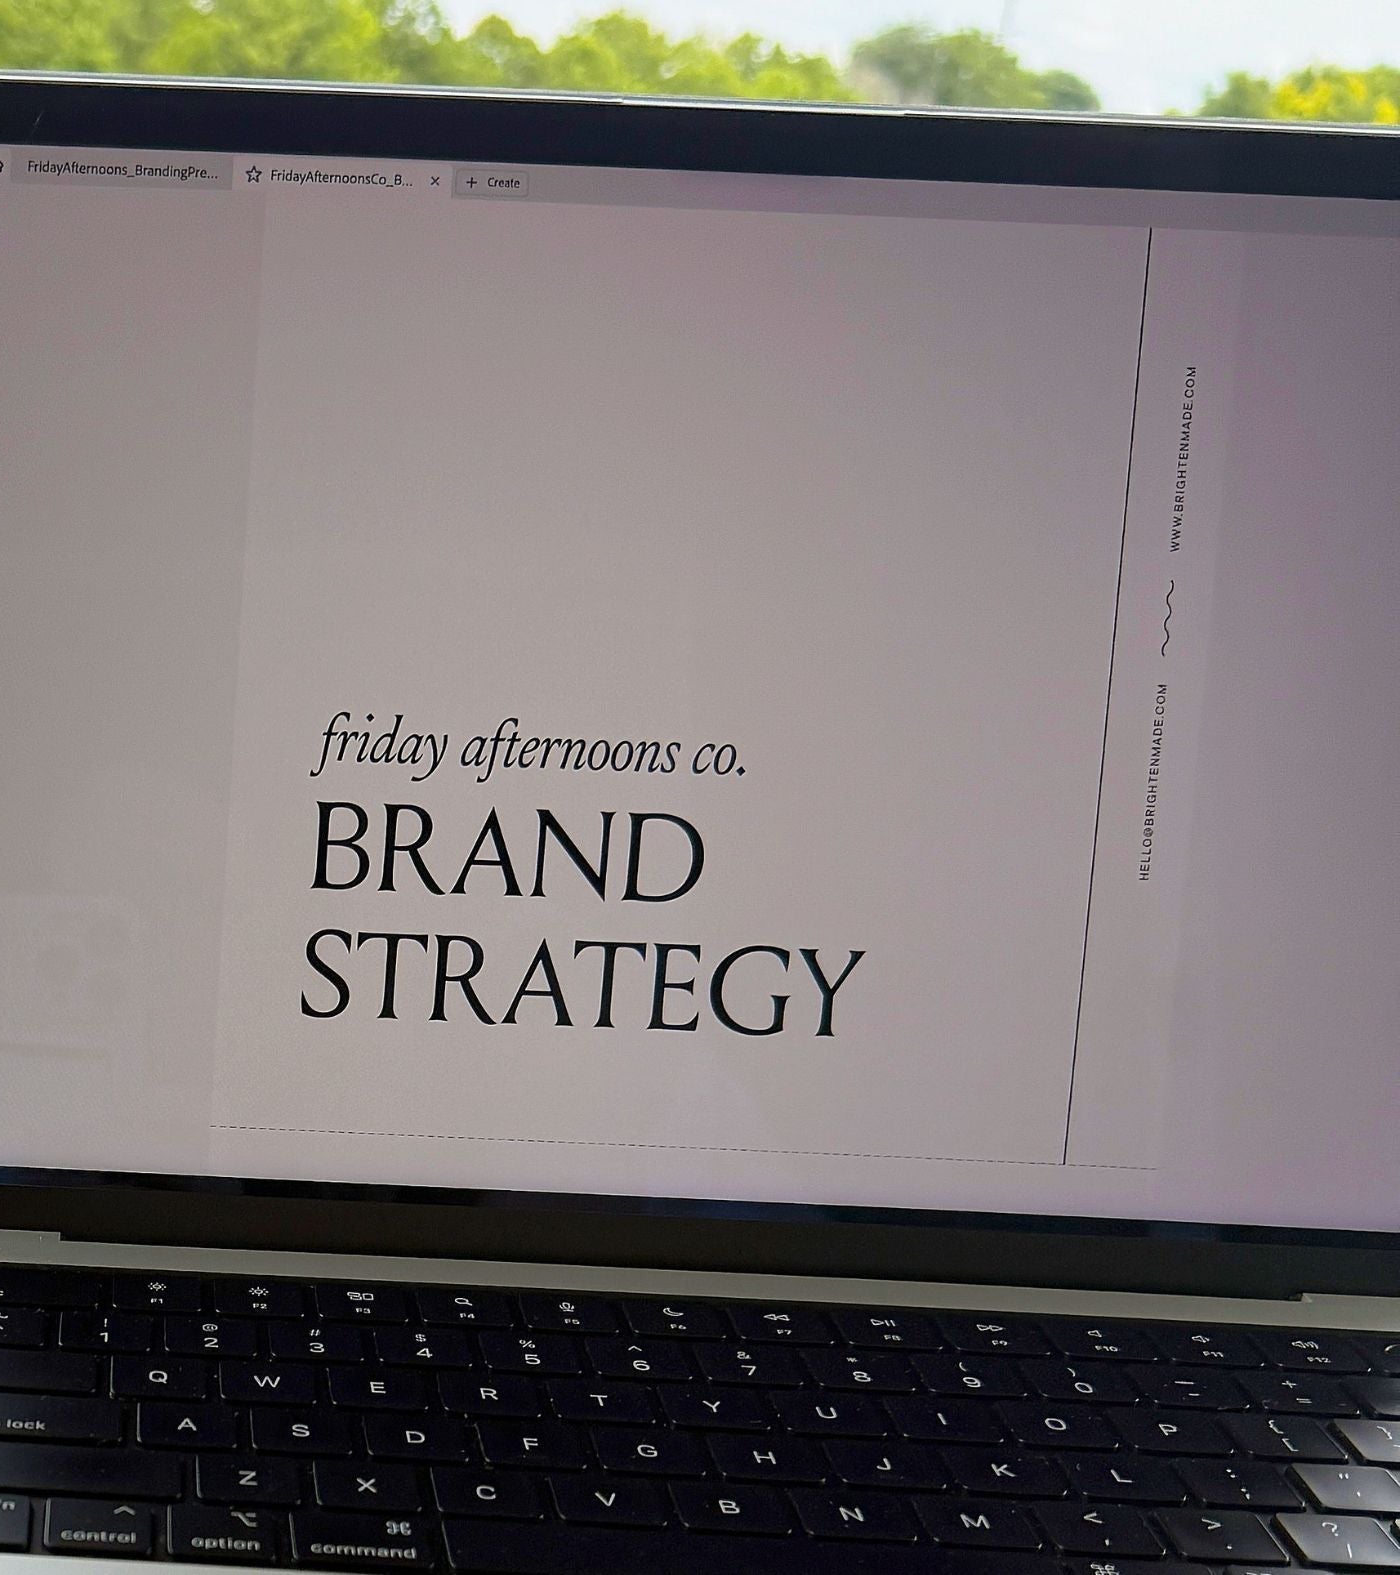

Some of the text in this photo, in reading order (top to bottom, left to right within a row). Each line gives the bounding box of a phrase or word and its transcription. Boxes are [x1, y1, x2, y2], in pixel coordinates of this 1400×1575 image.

[27, 160, 218, 182] FridayAfternoons_BrandingPre...
[270, 169, 413, 188] FridayAfternoonsCo_B...
[487, 176, 521, 189] Create
[1169, 366, 1197, 553] WWW.BRIGHTENMADE.COM
[309, 711, 746, 783] friday afternoons co.
[1138, 684, 1168, 881] HELLO@BRIGHTENMADE.COM
[310, 800, 705, 903] BRAND
[300, 928, 867, 1037] STRATEGY
[99, 1332, 109, 1343] 1
[203, 1337, 219, 1348] 2
[309, 1342, 325, 1353] 3
[416, 1347, 433, 1359] 4
[524, 1353, 541, 1365] 5
[632, 1359, 650, 1371] 6
[148, 1370, 168, 1384] Q
[740, 1364, 757, 1376] 7
[852, 1371, 871, 1383] 8
[253, 1375, 281, 1388] W
[369, 1381, 387, 1394] E
[962, 1376, 981, 1388] 9
[1074, 1381, 1094, 1394] 0
[479, 1387, 499, 1401] R
[589, 1394, 608, 1407] T
[702, 1400, 721, 1413] Y
[815, 1406, 838, 1419] U
[6, 1419, 45, 1430] lock
[177, 1417, 197, 1431] A
[291, 1423, 310, 1438] S
[1044, 1417, 1067, 1431] O
[1158, 1423, 1178, 1436] P
[405, 1430, 426, 1444] D
[522, 1437, 539, 1451] F
[636, 1444, 658, 1458] G
[752, 1450, 777, 1465] H
[876, 1457, 892, 1471] J
[991, 1463, 1016, 1478] K
[238, 1470, 258, 1486] Z
[1110, 1469, 1133, 1483] L
[356, 1477, 377, 1493] X
[475, 1485, 497, 1500] C
[594, 1492, 616, 1507] V
[718, 1499, 741, 1514] B
[838, 1506, 864, 1522] N
[959, 1513, 990, 1529] M
[60, 1530, 137, 1544] control
[191, 1537, 260, 1551] option
[310, 1543, 417, 1559] command
